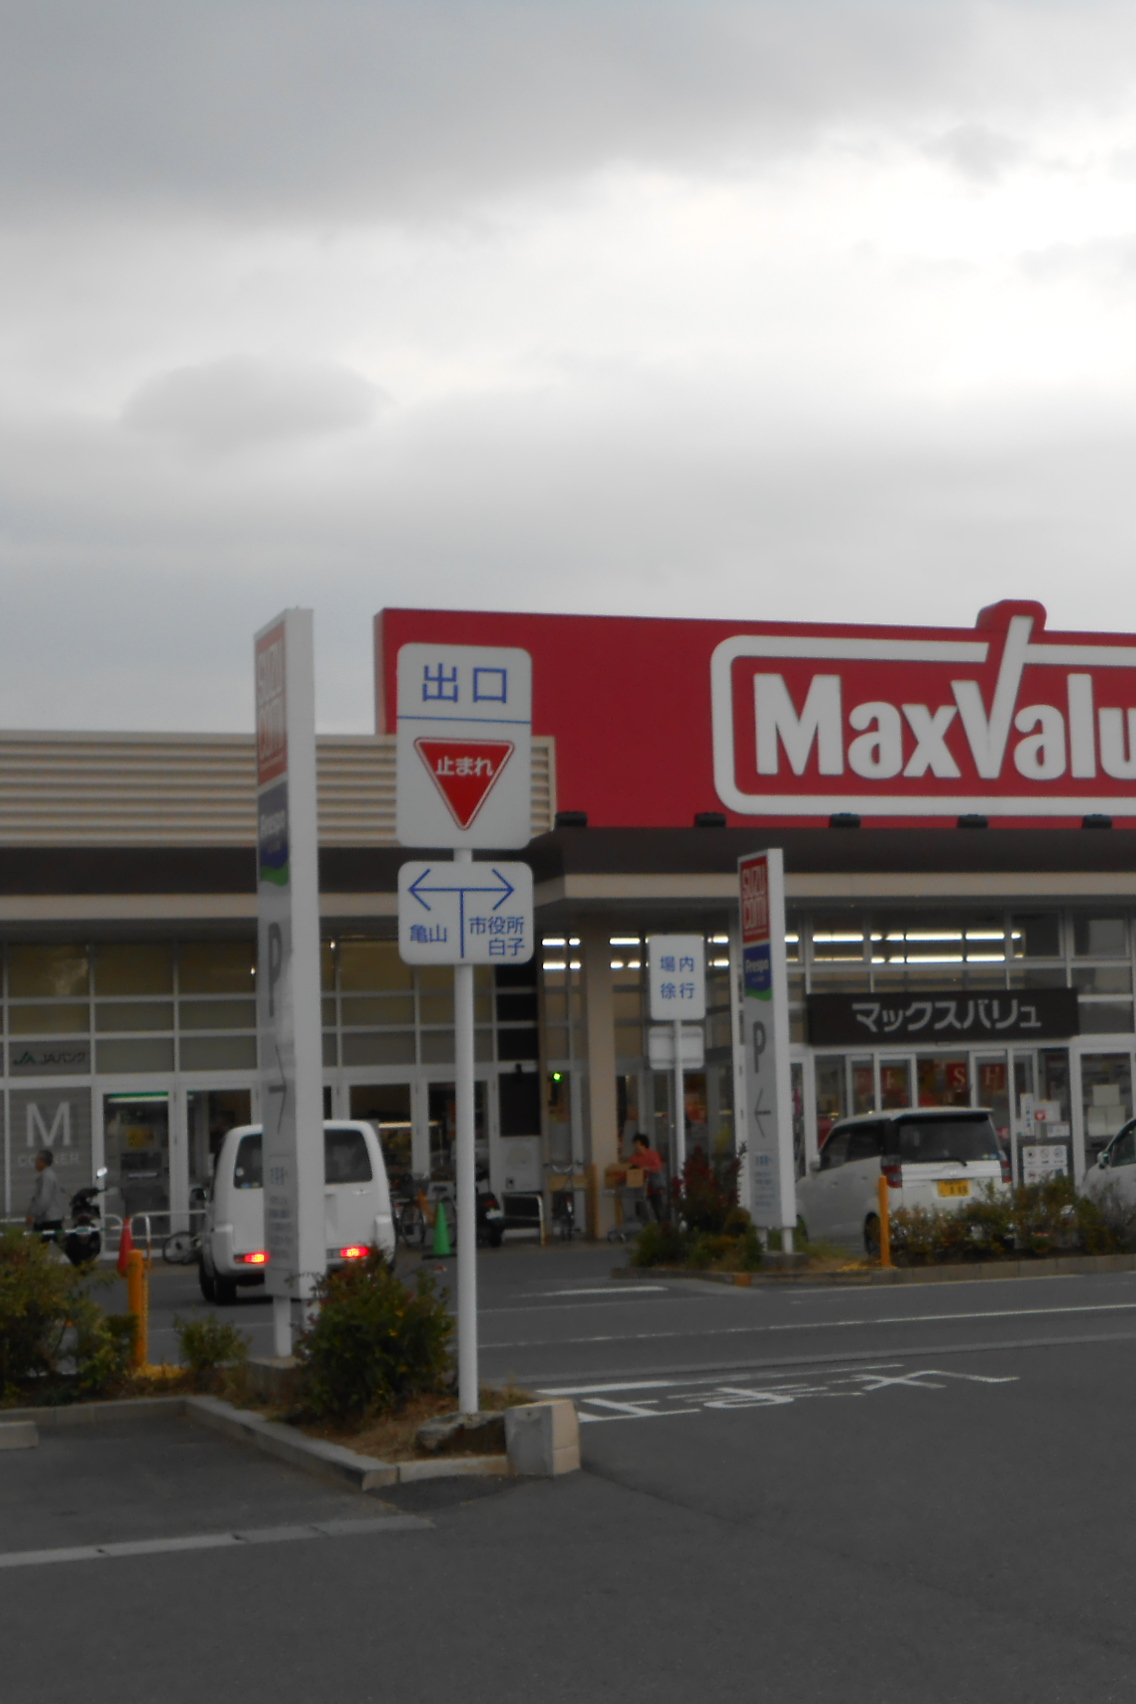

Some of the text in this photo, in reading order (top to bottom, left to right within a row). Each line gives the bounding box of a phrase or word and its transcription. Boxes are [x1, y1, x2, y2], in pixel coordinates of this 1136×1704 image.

[422, 662, 507, 703] 出口
[435, 756, 494, 777] 止まれ
[409, 924, 448, 943] 亀山
[469, 916, 525, 935] 市役所
[488, 938, 525, 957] 白子
[660, 982, 696, 999] 徐行
[851, 998, 1042, 1033] マックスバリュ
[753, 1021, 767, 1074] P
[26, 1101, 71, 1148] M
